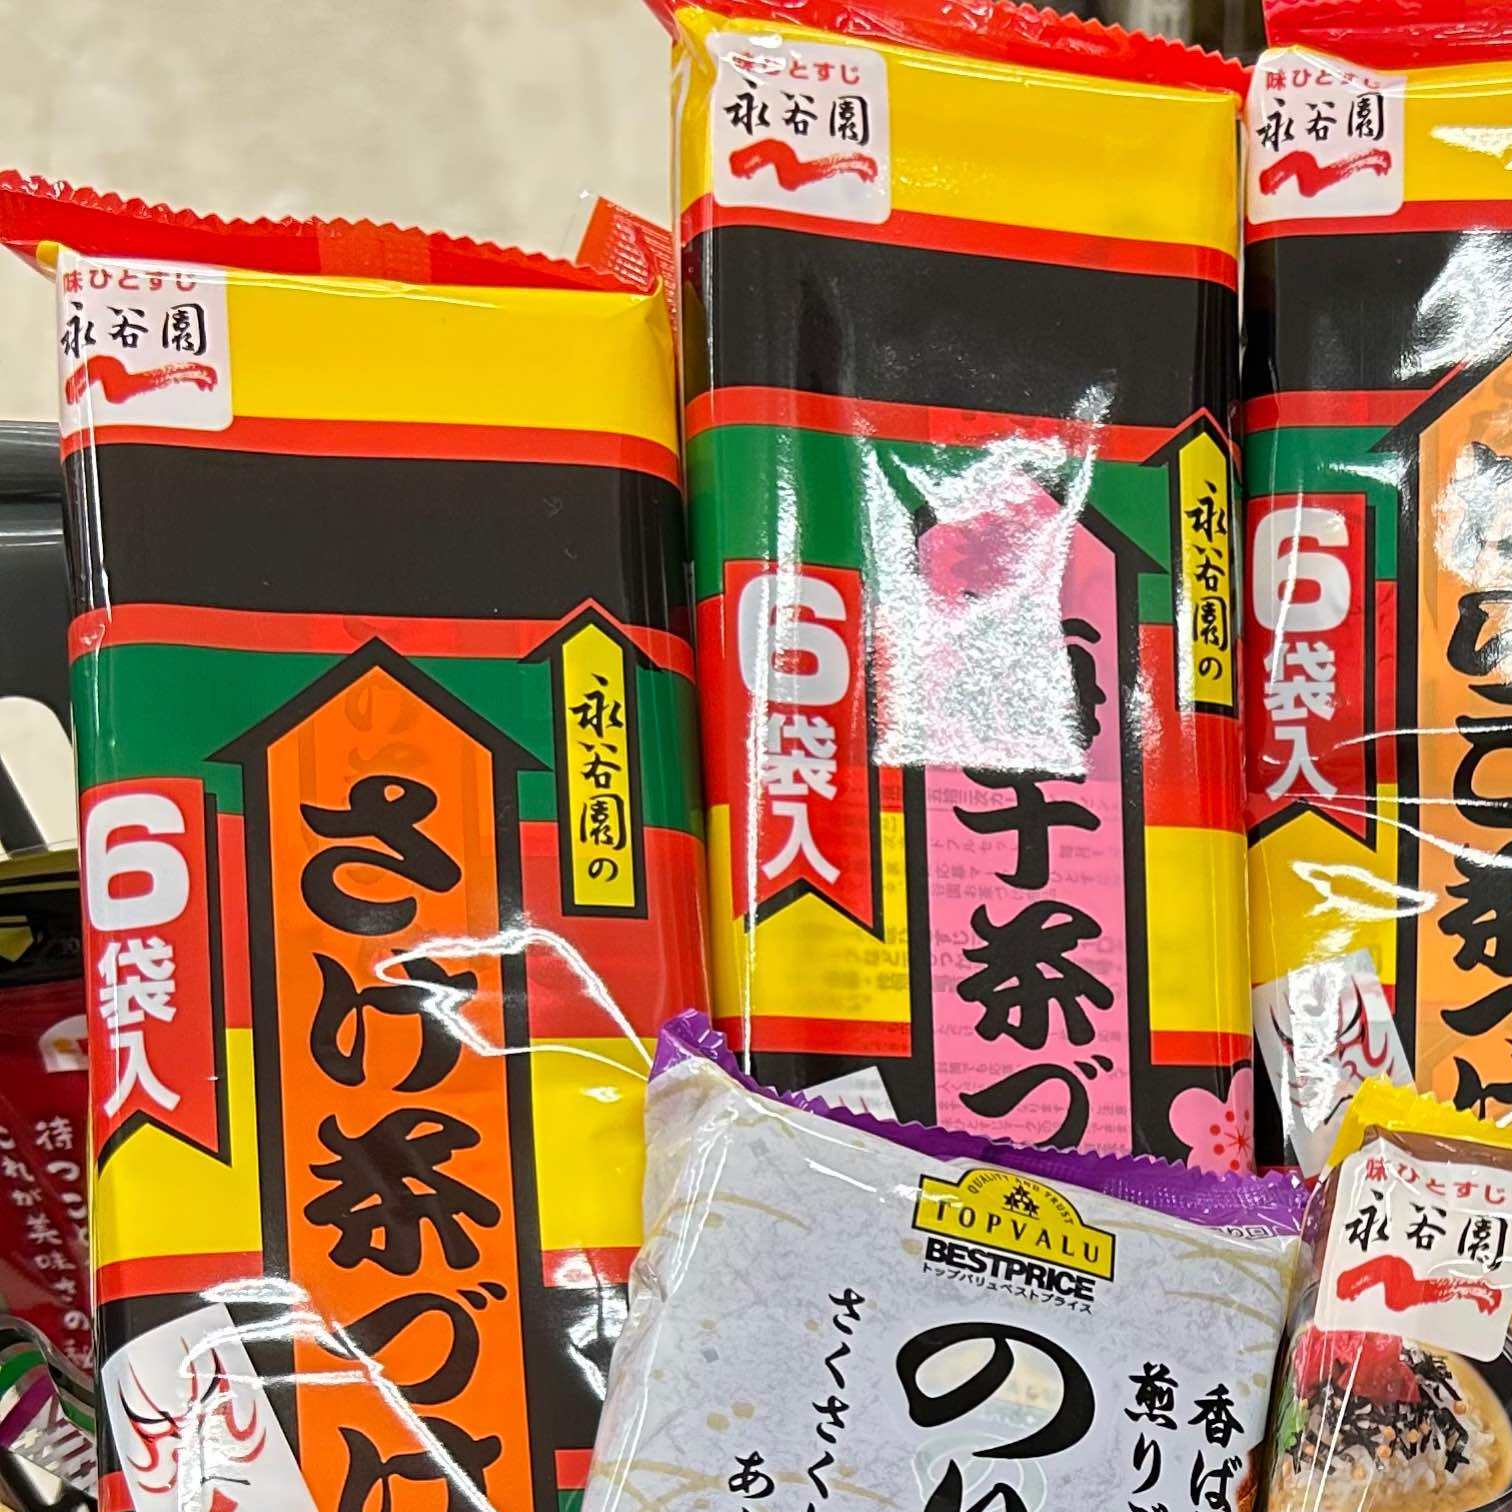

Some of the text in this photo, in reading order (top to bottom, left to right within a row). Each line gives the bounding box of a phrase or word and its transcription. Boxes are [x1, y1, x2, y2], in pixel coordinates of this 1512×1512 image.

[725, 80, 870, 147] 永谷園
[1256, 93, 1385, 152] 永谷園
[63, 267, 197, 292] 味ひとすじ
[60, 302, 206, 357] 永谷園
[1185, 480, 1229, 683] 永谷園の
[1250, 506, 1352, 800] 6袋入
[735, 572, 850, 886] 6袋入
[569, 674, 627, 883] 永谷園の
[953, 592, 1114, 1148] 干茶づ
[84, 792, 190, 1118] 6袋入
[968, 1172, 1009, 1194] QUALITY
[1044, 1190, 1075, 1226] TRUST
[1364, 1157, 1506, 1204] 味ひとすじ
[935, 1200, 1100, 1264] TOPVALU
[1345, 1190, 1508, 1271] 永谷園
[925, 1237, 1095, 1302] BESTPRICE
